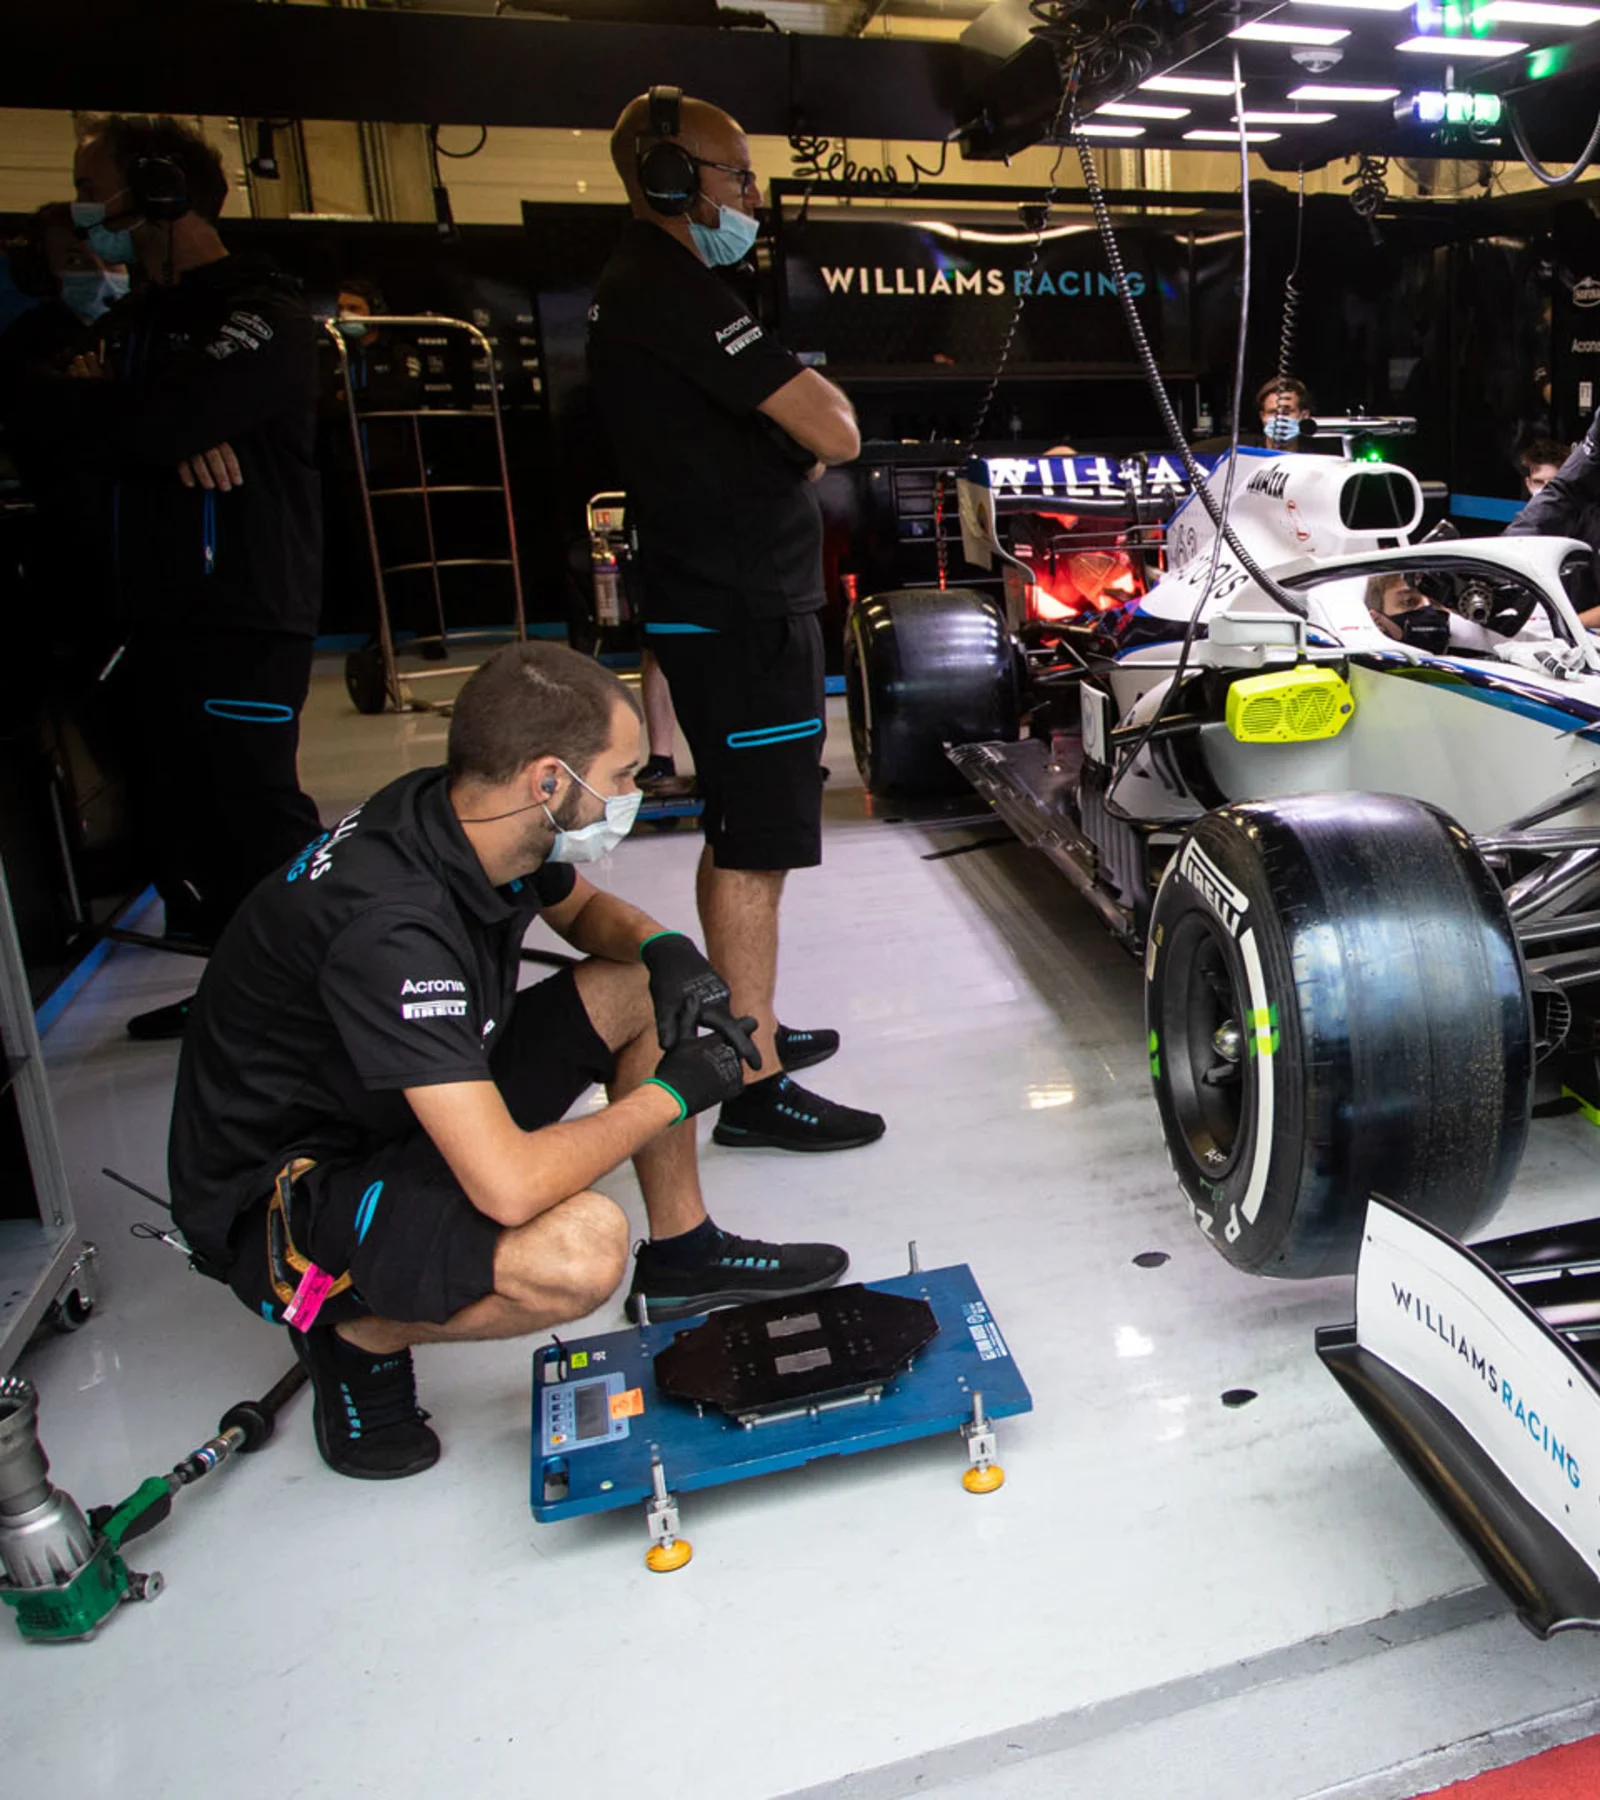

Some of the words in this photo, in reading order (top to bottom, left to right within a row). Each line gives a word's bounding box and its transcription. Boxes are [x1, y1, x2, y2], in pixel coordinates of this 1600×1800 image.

[821, 267, 1004, 294] WILLIAMS
[1014, 270, 1146, 295] RACING
[1180, 837, 1250, 937] PIRELLI
[1392, 1282, 1498, 1393] WILLIAMS
[1502, 1379, 1581, 1489] RACING
